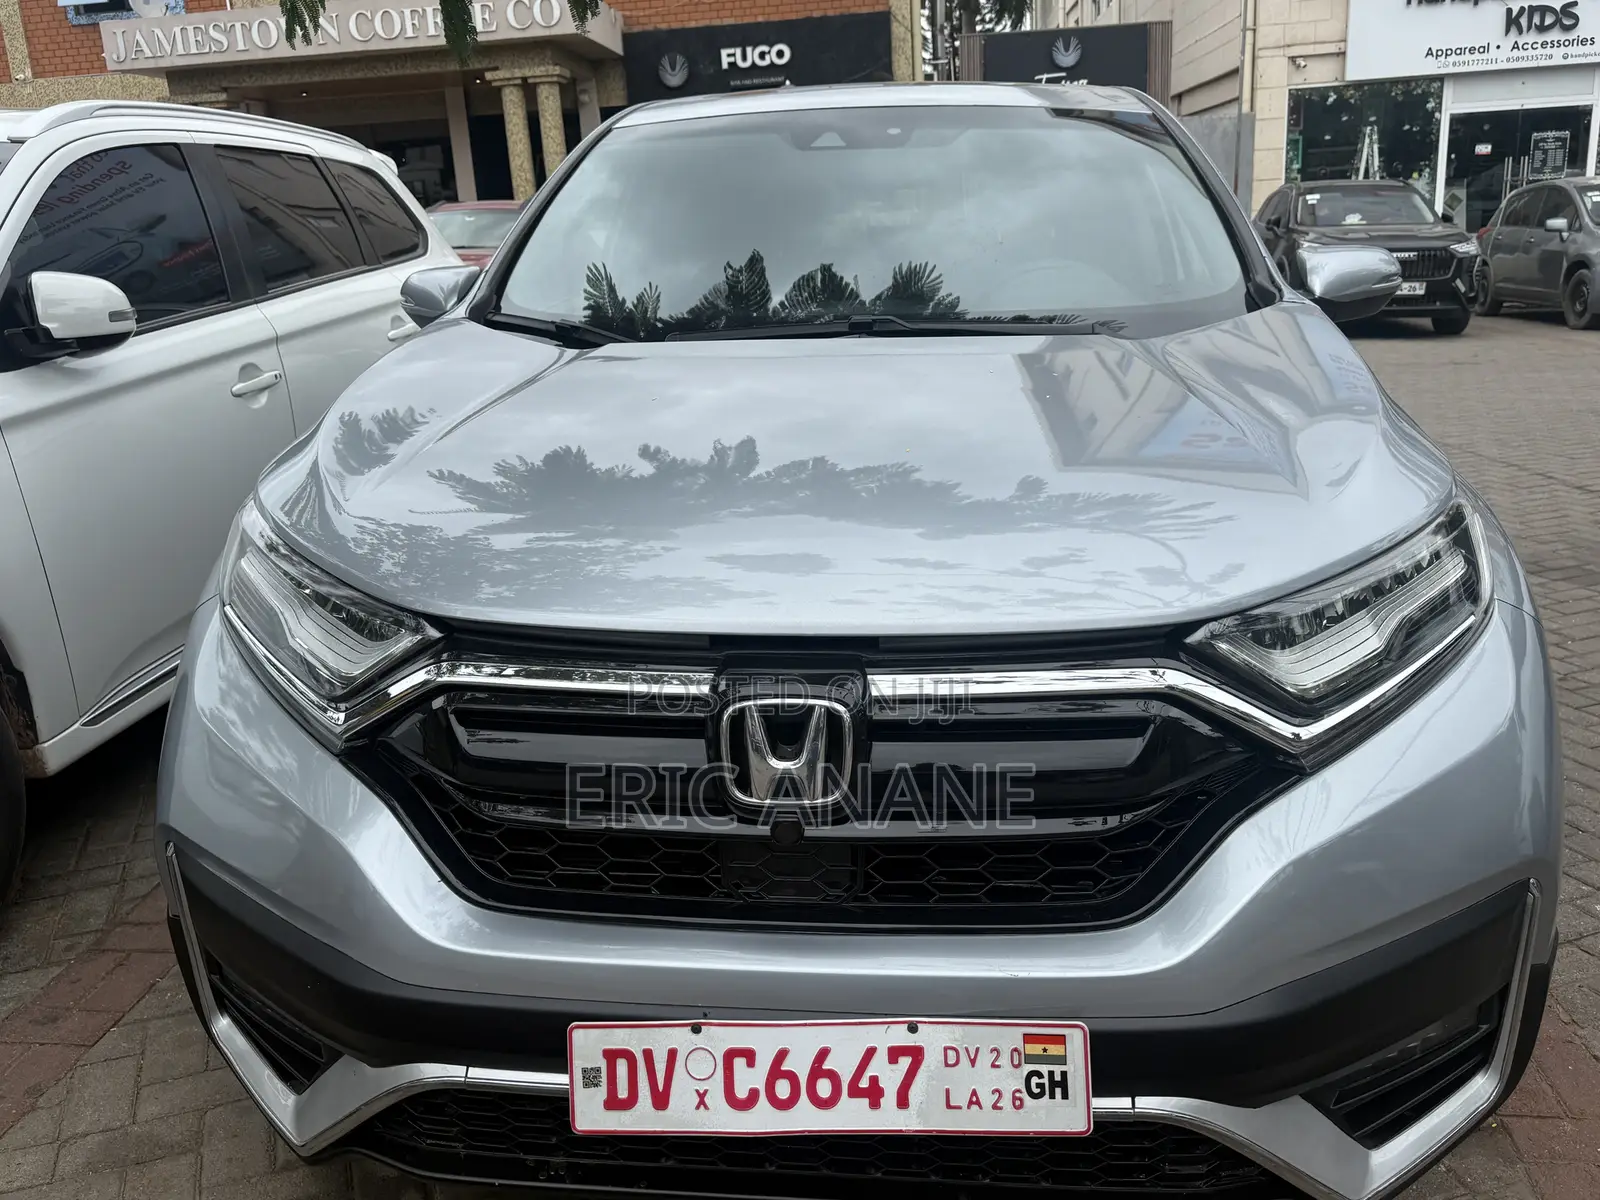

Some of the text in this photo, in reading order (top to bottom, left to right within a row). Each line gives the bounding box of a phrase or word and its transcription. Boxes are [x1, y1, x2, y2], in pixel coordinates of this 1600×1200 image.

[349, 1, 497, 42] COFFE
[506, 0, 561, 30] CO
[1504, 1, 1580, 36] KIDS
[720, 43, 791, 70] FUGO
[1424, 35, 1596, 60] Appareal Accessories
[602, 1045, 679, 1111] DV
[722, 1044, 926, 1111] C6647
[1024, 1069, 1070, 1100] GH
